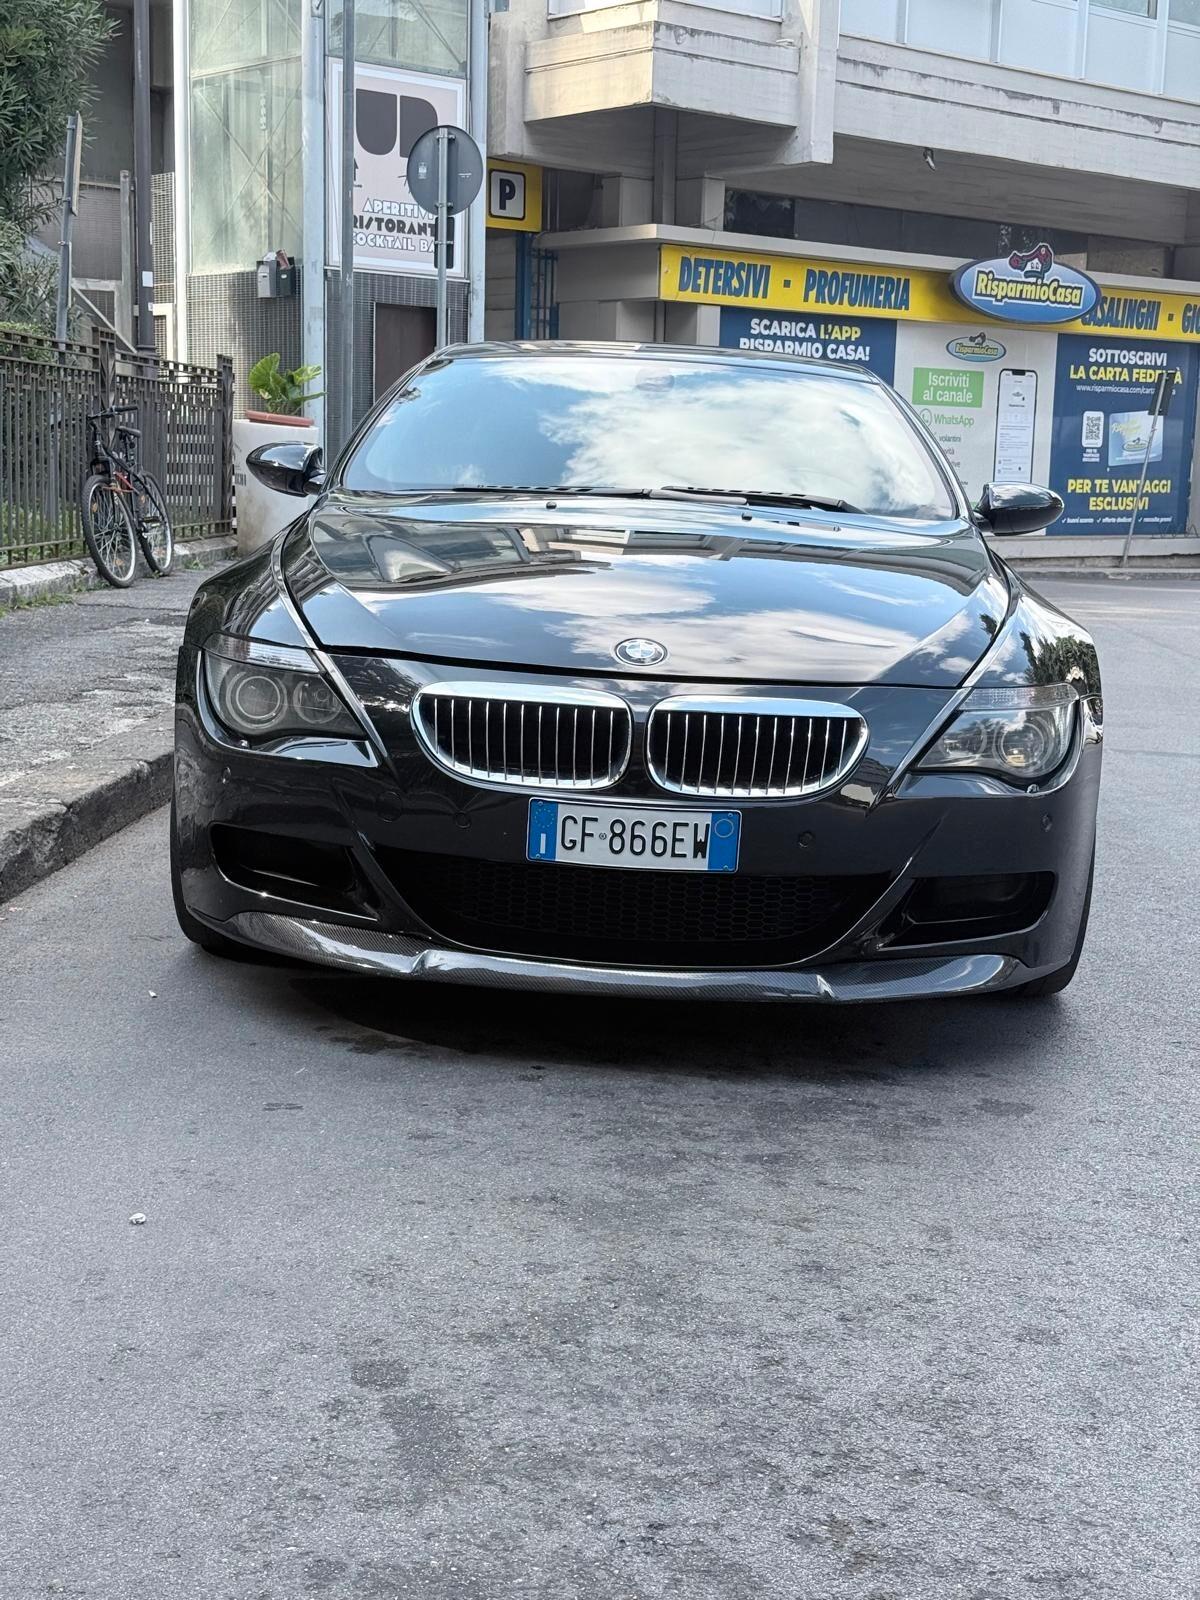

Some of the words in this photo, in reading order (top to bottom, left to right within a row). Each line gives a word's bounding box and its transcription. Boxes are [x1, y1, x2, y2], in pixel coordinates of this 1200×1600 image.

[499, 178, 516, 211] P
[353, 215, 436, 236] ISTORANT
[678, 256, 771, 299] DETERSIVI
[803, 269, 911, 311] PROFUMERIA
[975, 271, 1083, 307] RisparmioCasa
[1081, 296, 1162, 331] ASALINGHI
[750, 318, 817, 339] SCARICA
[819, 323, 861, 341] L'APP
[739, 338, 823, 358] RISPARMIO
[826, 343, 870, 361] CASA!
[1088, 347, 1168, 366] SOTTOSCRIVI
[928, 372, 970, 387] Iscriviti
[1069, 364, 1086, 380] LA
[1089, 366, 1129, 382] CARTA
[1132, 367, 1183, 385] FEDÀ
[923, 387, 934, 401] al
[936, 389, 973, 403] canale
[934, 413, 975, 427] WhatsApp
[1067, 479, 1092, 493] PER
[1094, 479, 1109, 493] TE
[1089, 497, 1149, 511] ESCLUSIVI
[560, 815, 599, 852] GF
[608, 818, 711, 859] 866EW
